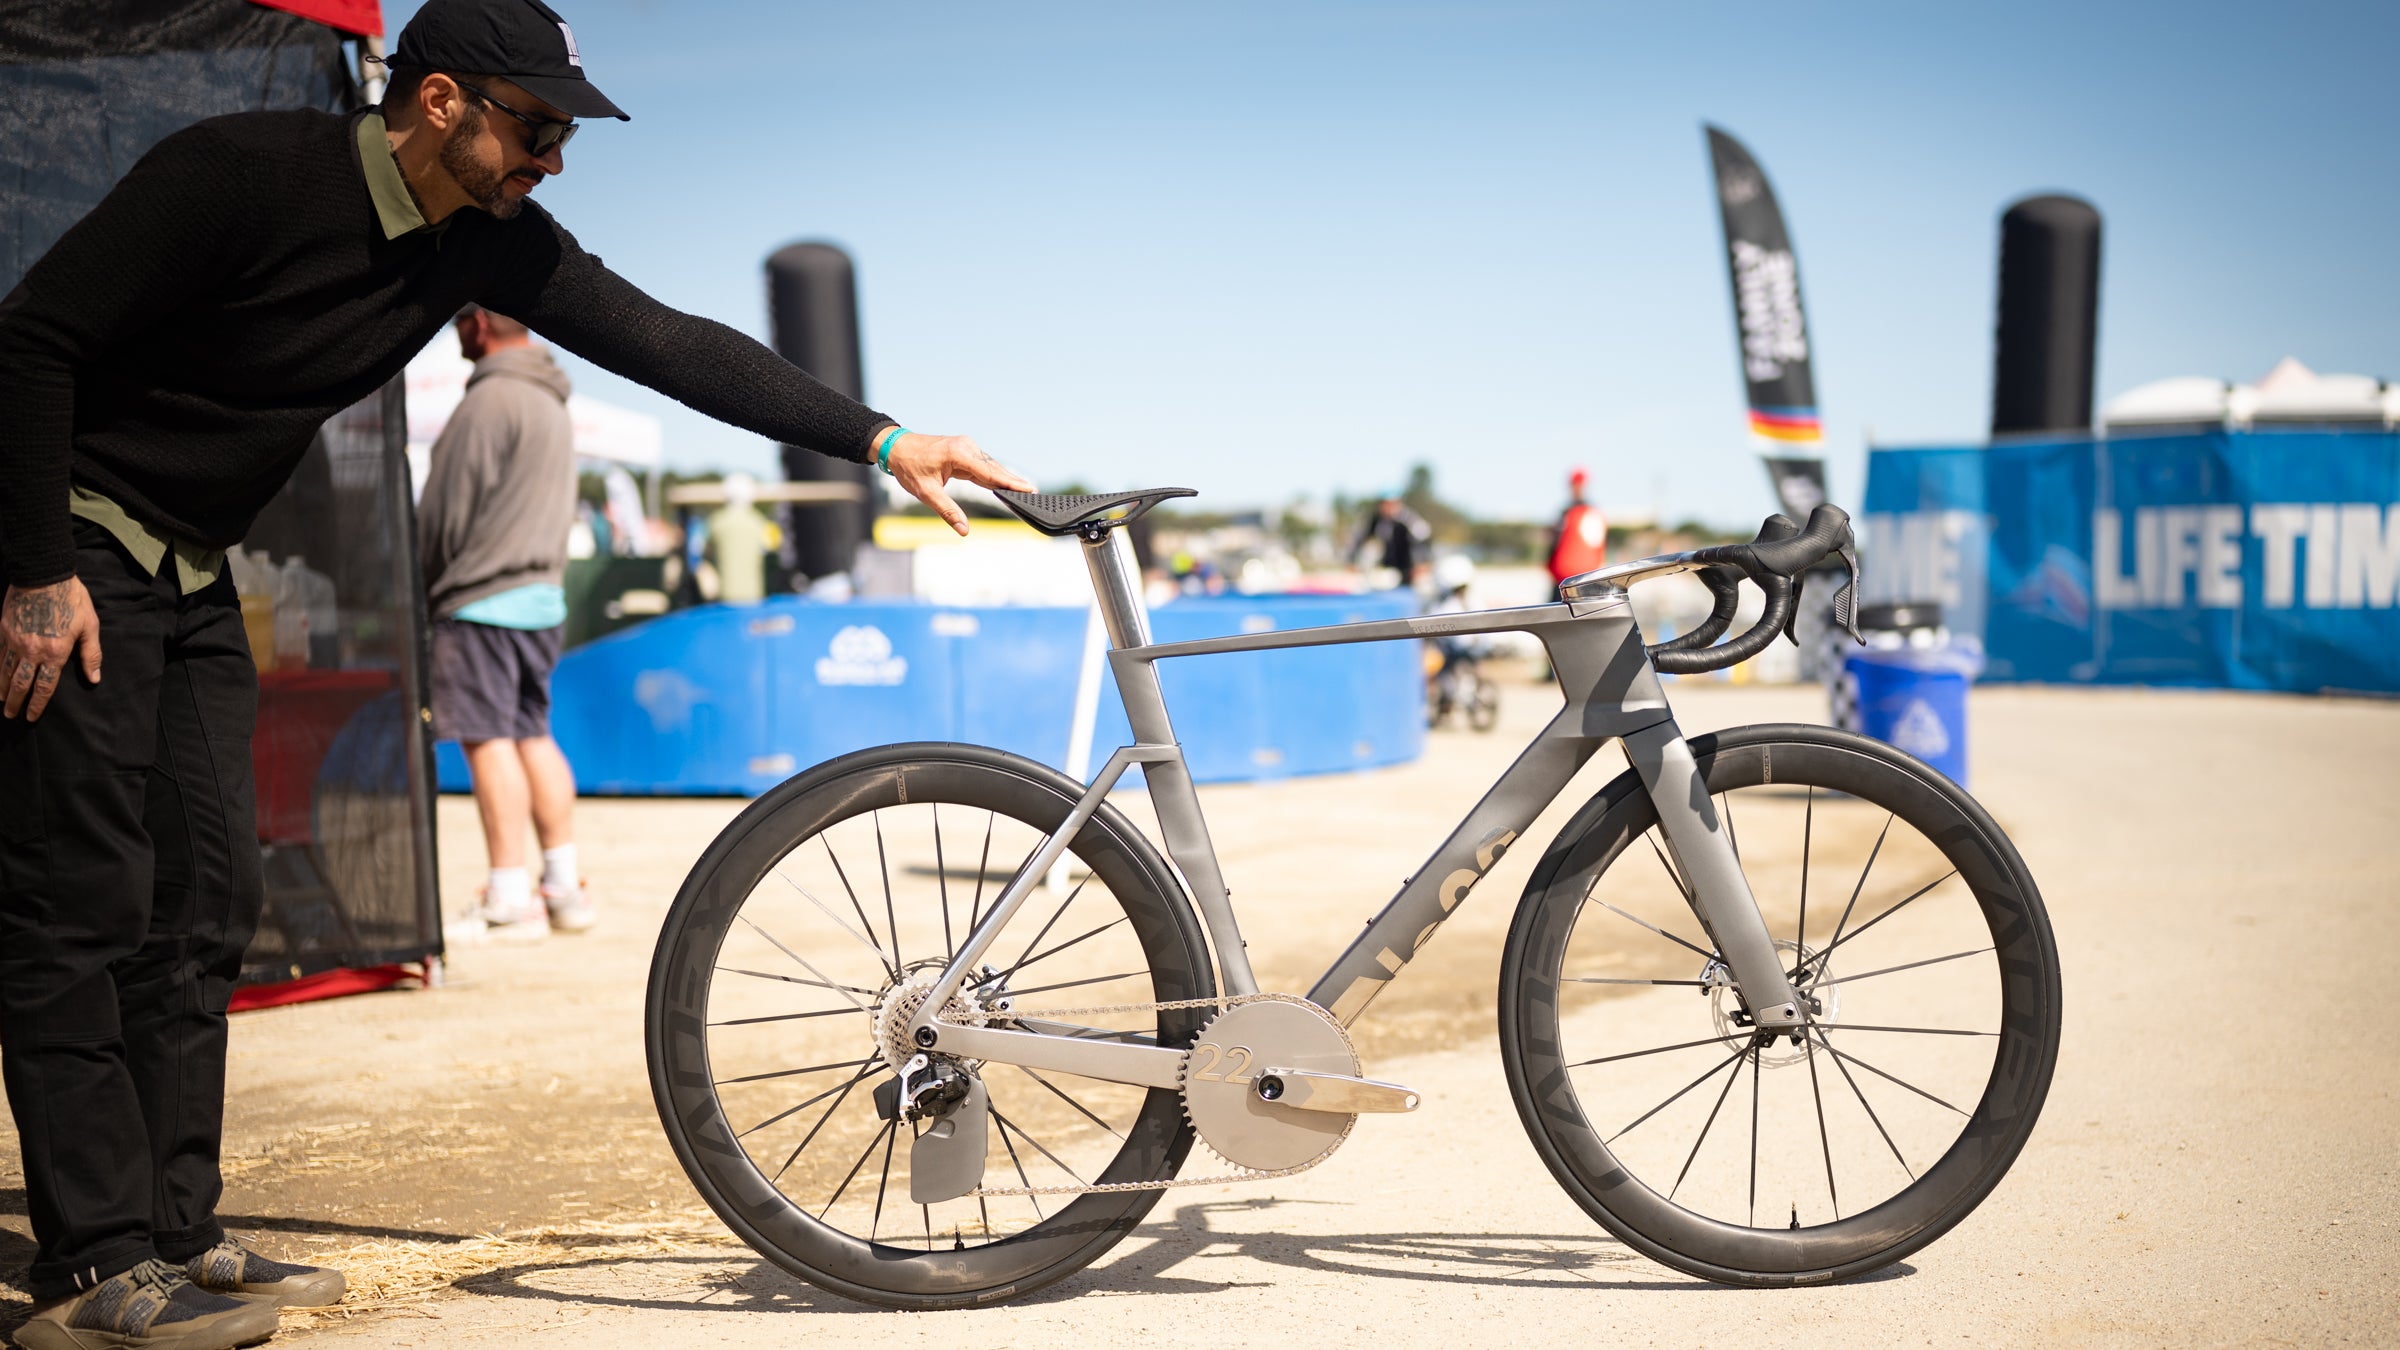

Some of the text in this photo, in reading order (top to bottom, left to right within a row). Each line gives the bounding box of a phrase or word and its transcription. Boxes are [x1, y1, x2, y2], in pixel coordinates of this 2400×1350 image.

[1413, 623, 1456, 634] REACTOR
[2093, 503, 2400, 609] LIFE TIM
[668, 871, 791, 1221] CADEX
[1073, 835, 1195, 1182] CADX
[1193, 1042, 1254, 1085] 22
[1937, 823, 2041, 1165] CADEX
